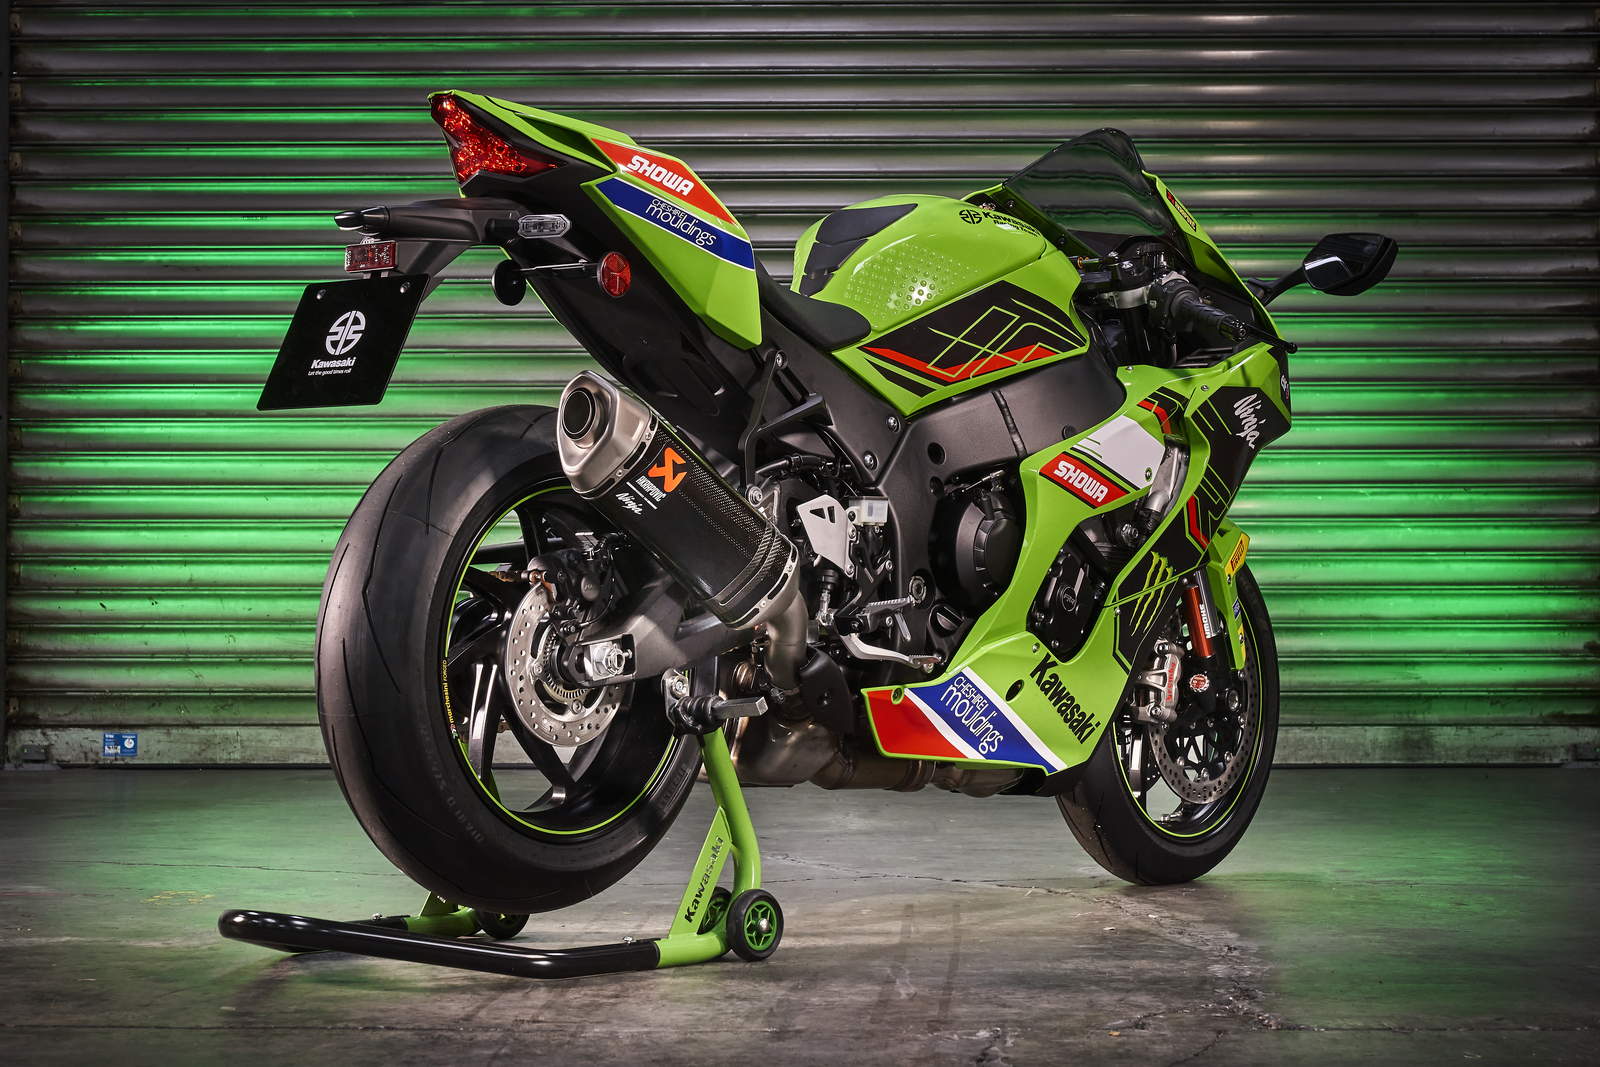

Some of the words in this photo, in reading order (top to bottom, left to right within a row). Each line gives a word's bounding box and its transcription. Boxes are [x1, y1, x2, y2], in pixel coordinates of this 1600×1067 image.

[627, 155, 695, 196] SHOWA
[646, 203, 717, 246] mouldings
[651, 199, 686, 218] CHESHIRE
[311, 357, 356, 369] Kawasaki
[1233, 393, 1266, 450] Ninja
[1053, 460, 1109, 503] SHOWA
[442, 683, 454, 723] marchesini
[953, 676, 987, 708] CHESHIRE
[1029, 652, 1101, 744] Kawasaki
[940, 684, 1004, 755] mouldings
